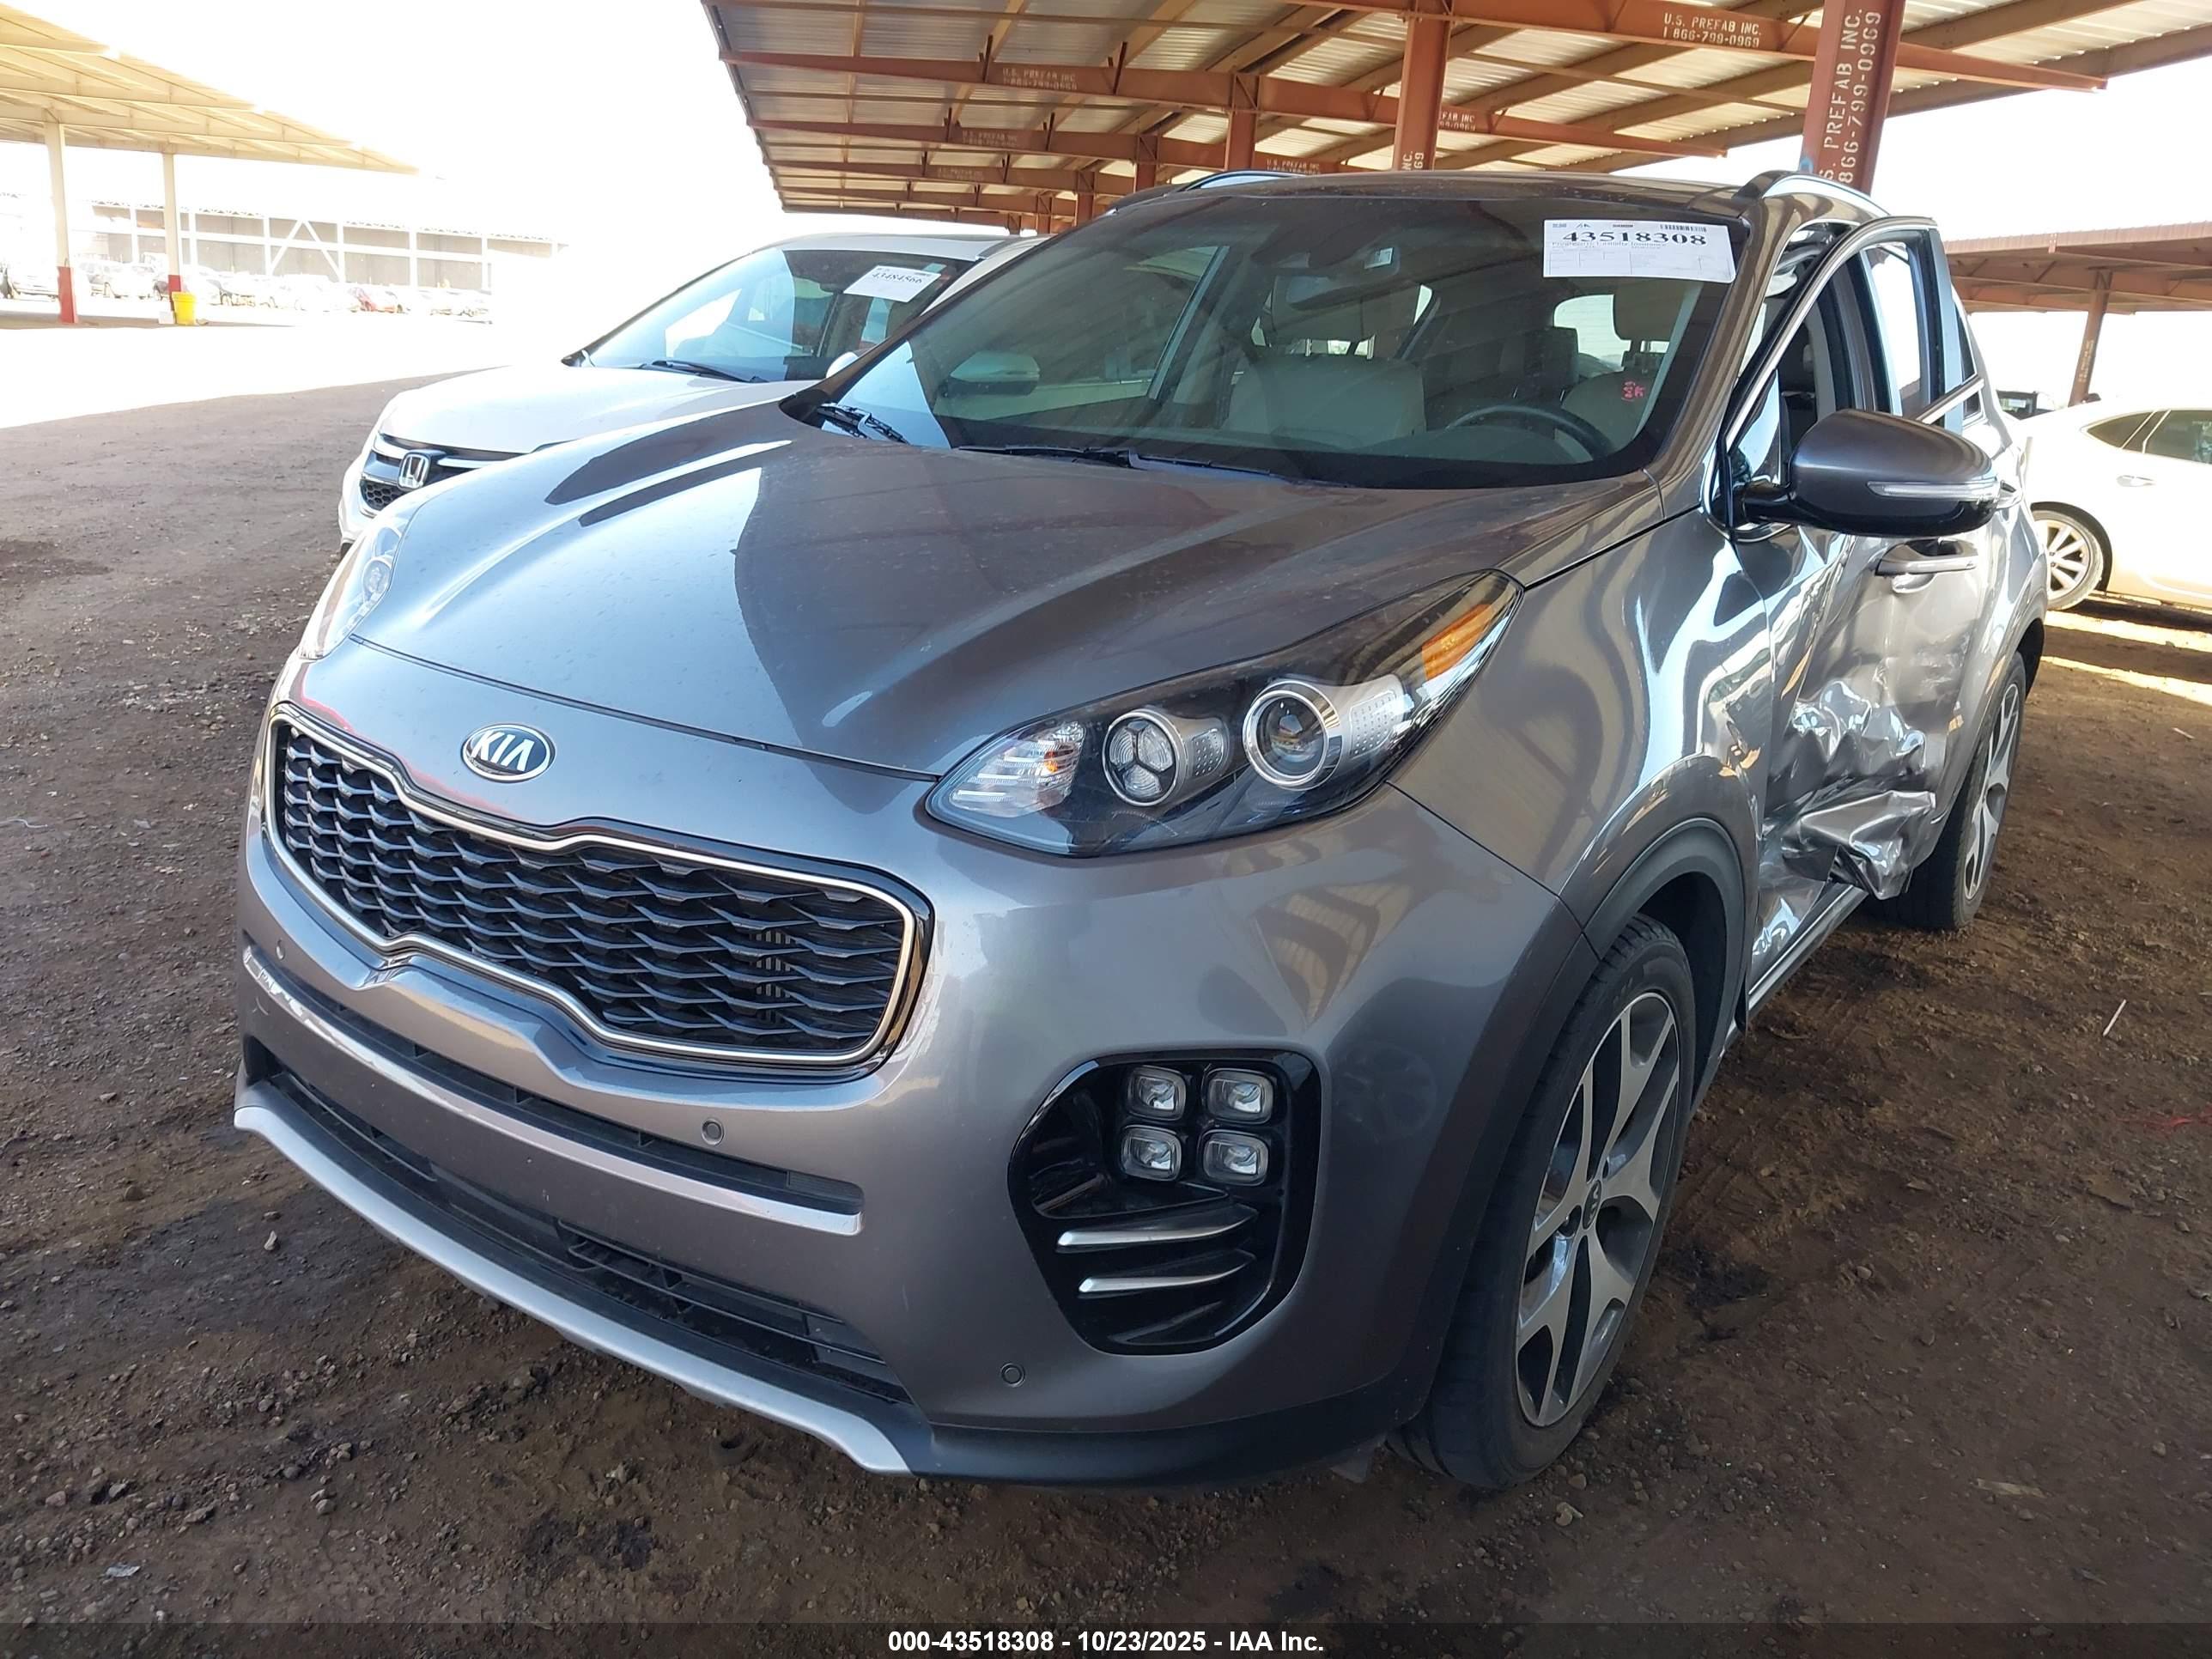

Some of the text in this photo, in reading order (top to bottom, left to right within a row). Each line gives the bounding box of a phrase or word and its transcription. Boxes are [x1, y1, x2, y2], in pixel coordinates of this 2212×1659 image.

[1664, 12, 1762, 36] U.S. PREFAB INC.
[1673, 27, 1759, 48] 866-799-0969
[1824, 62, 1853, 149] PREFAB
[1840, 9, 1863, 50] INC.
[1401, 150, 1414, 170] NC.
[1562, 231, 1707, 246] 43518308
[471, 730, 535, 772] KIA
